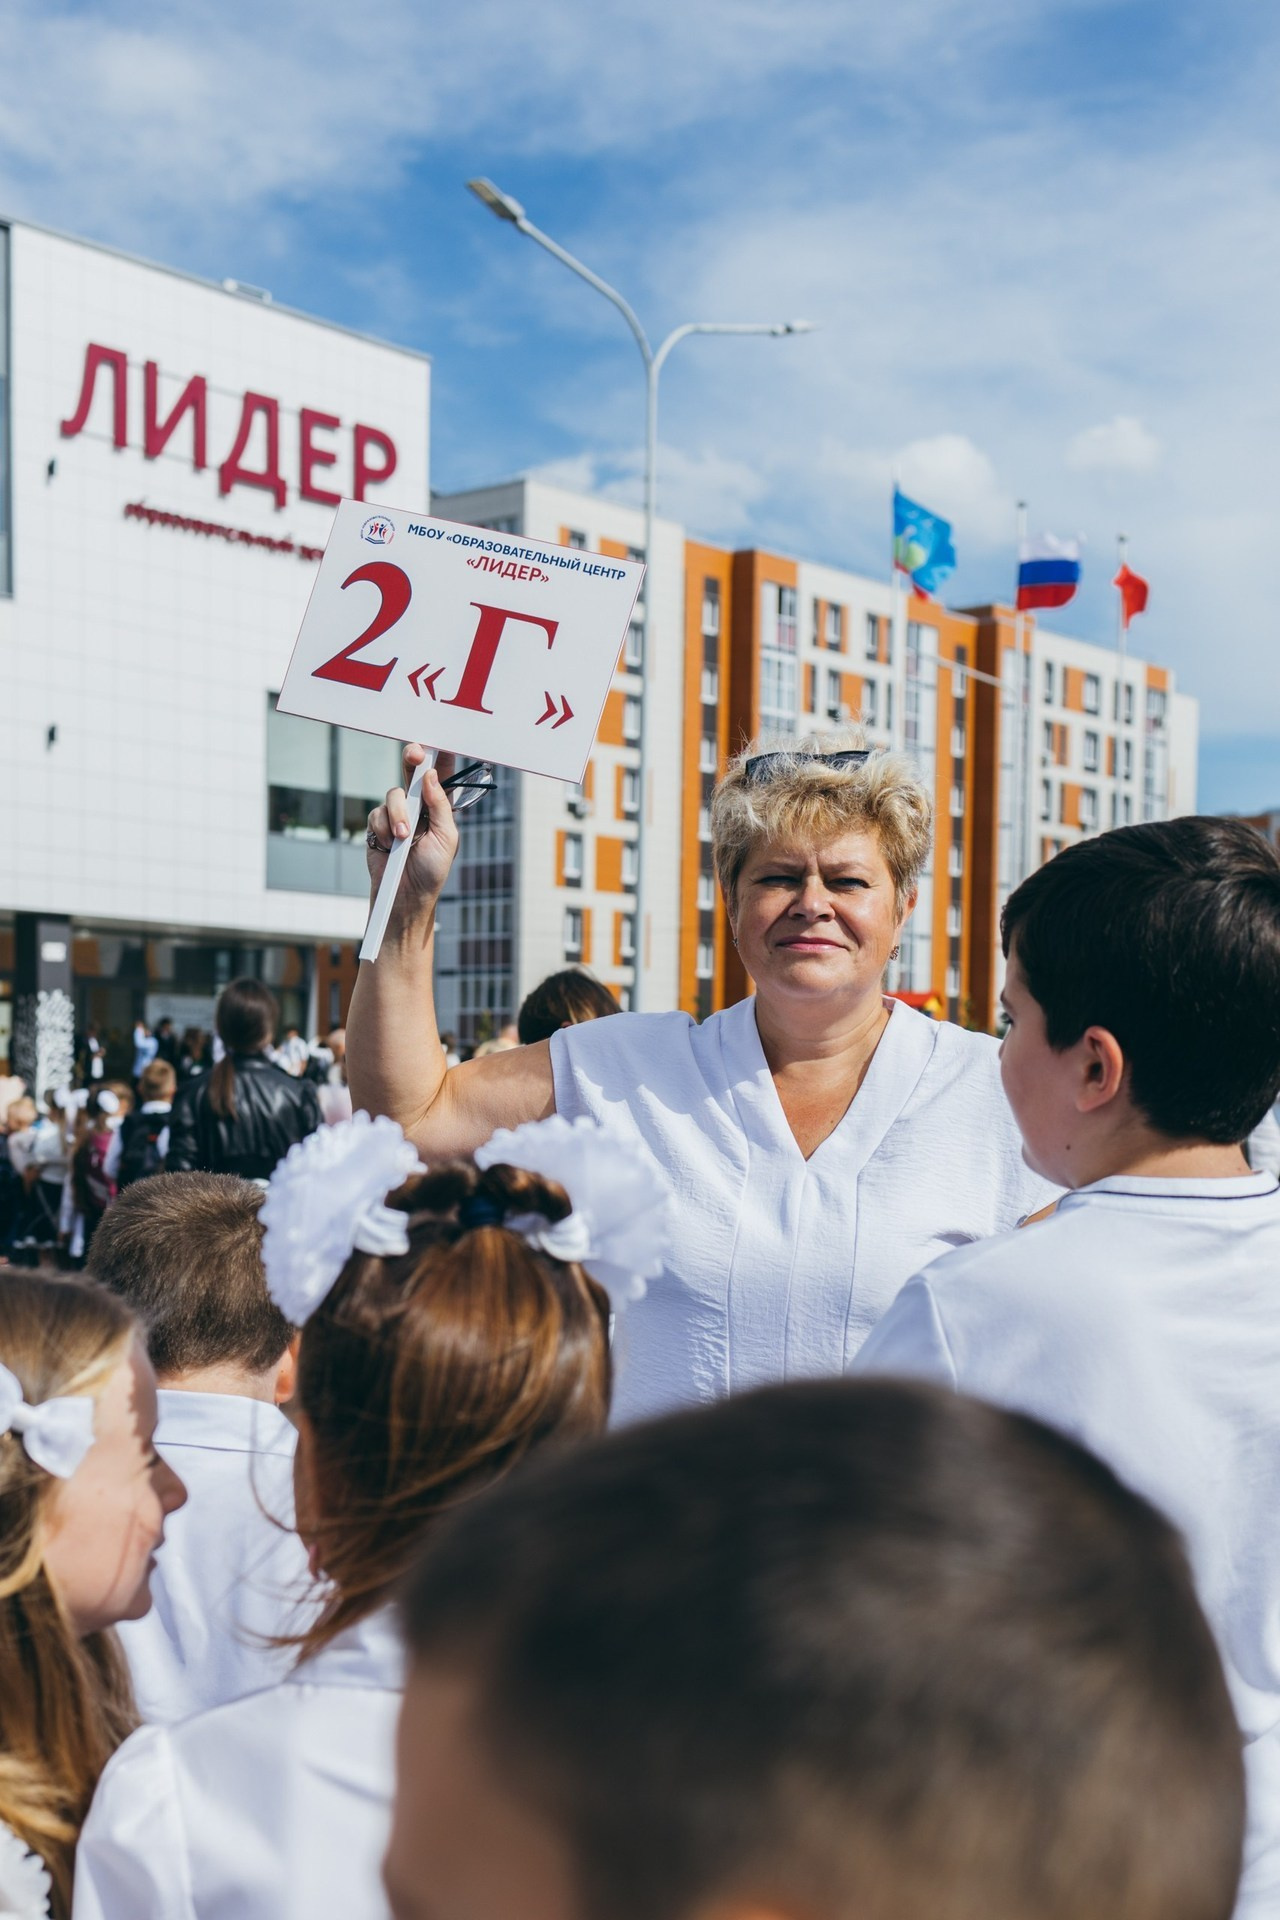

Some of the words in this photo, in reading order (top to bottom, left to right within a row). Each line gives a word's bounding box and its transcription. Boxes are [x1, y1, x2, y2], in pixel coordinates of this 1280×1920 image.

[60, 342, 397, 509] ЛИДЕР
[407, 523, 445, 540] МБОУ
[446, 533, 581, 571] «ОБРАЗОВАТЕЛЬНЫЙ
[582, 562, 626, 581] ЦЕНТР
[466, 555, 550, 583] «ЛИДЕР»
[311, 561, 412, 692] 2
